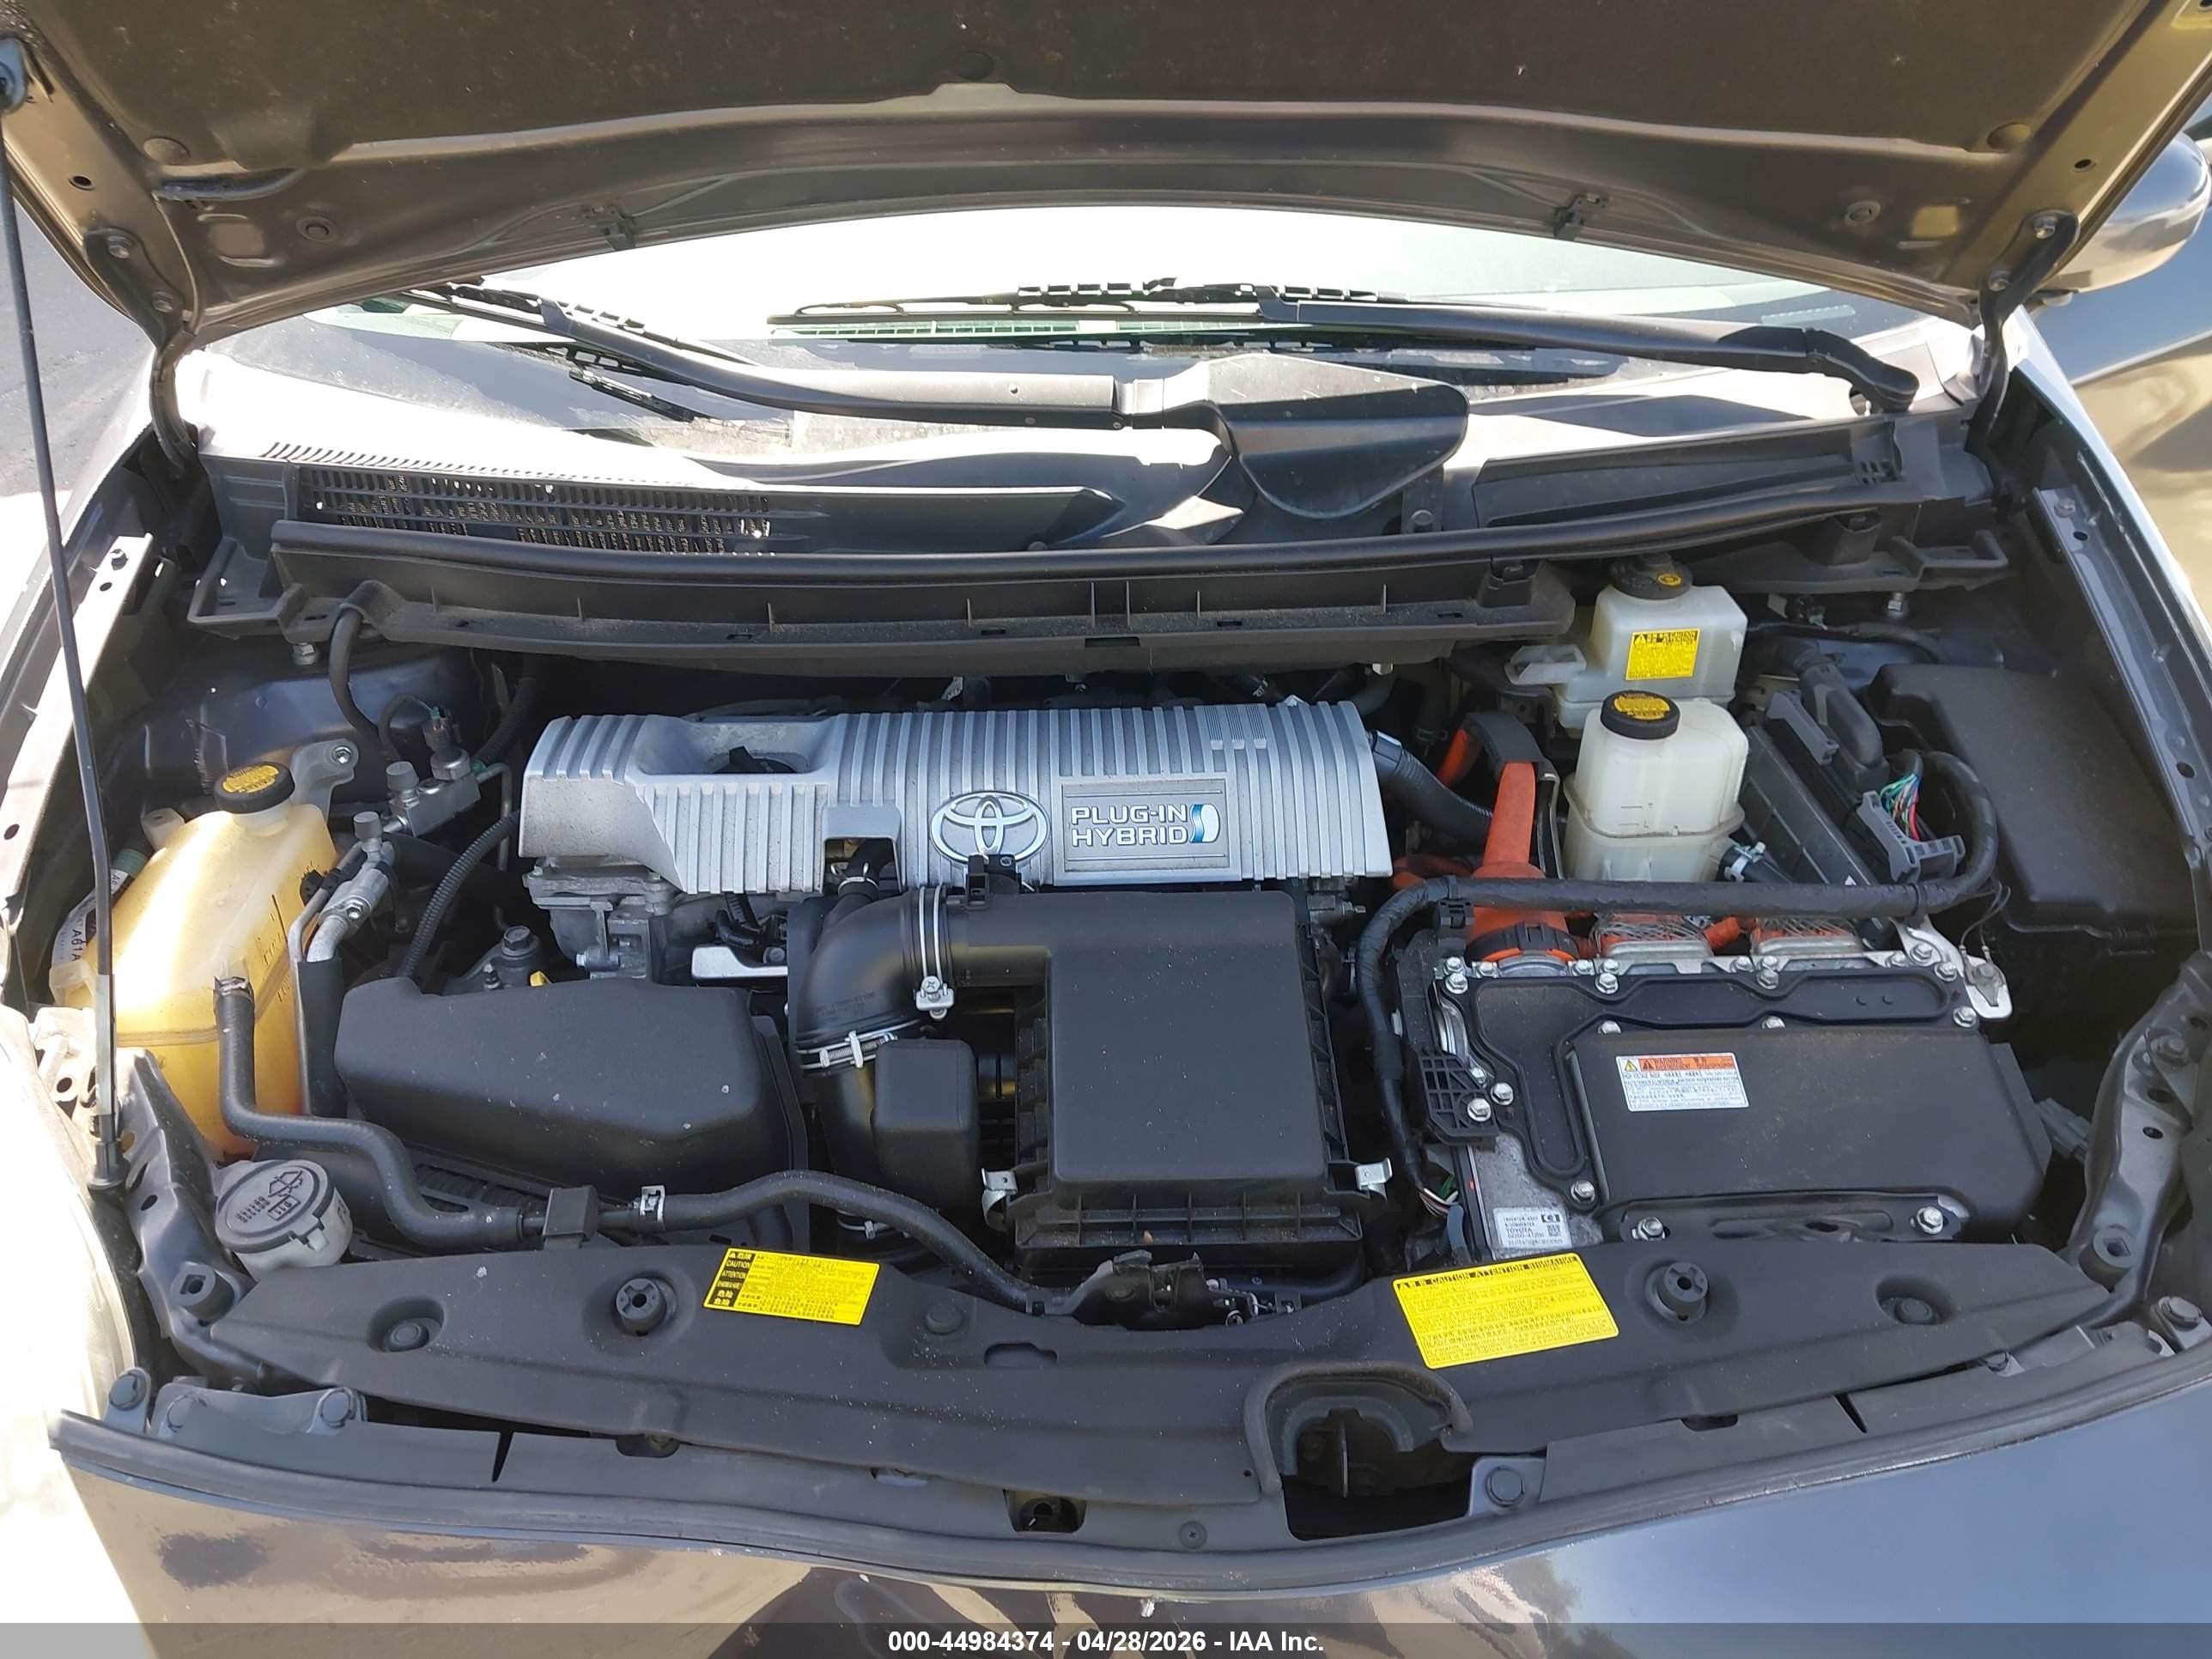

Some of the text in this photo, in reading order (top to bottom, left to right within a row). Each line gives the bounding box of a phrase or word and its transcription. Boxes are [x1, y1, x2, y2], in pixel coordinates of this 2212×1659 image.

[1071, 804, 1187, 825] PLUG-IN
[1072, 825, 1188, 848] HYBRID
[726, 1260, 750, 1268] CAUTION
[721, 1270, 746, 1279] ATTENTION
[1431, 1273, 1470, 1285] CAUTION
[1475, 1265, 1523, 1278] ATTENTION
